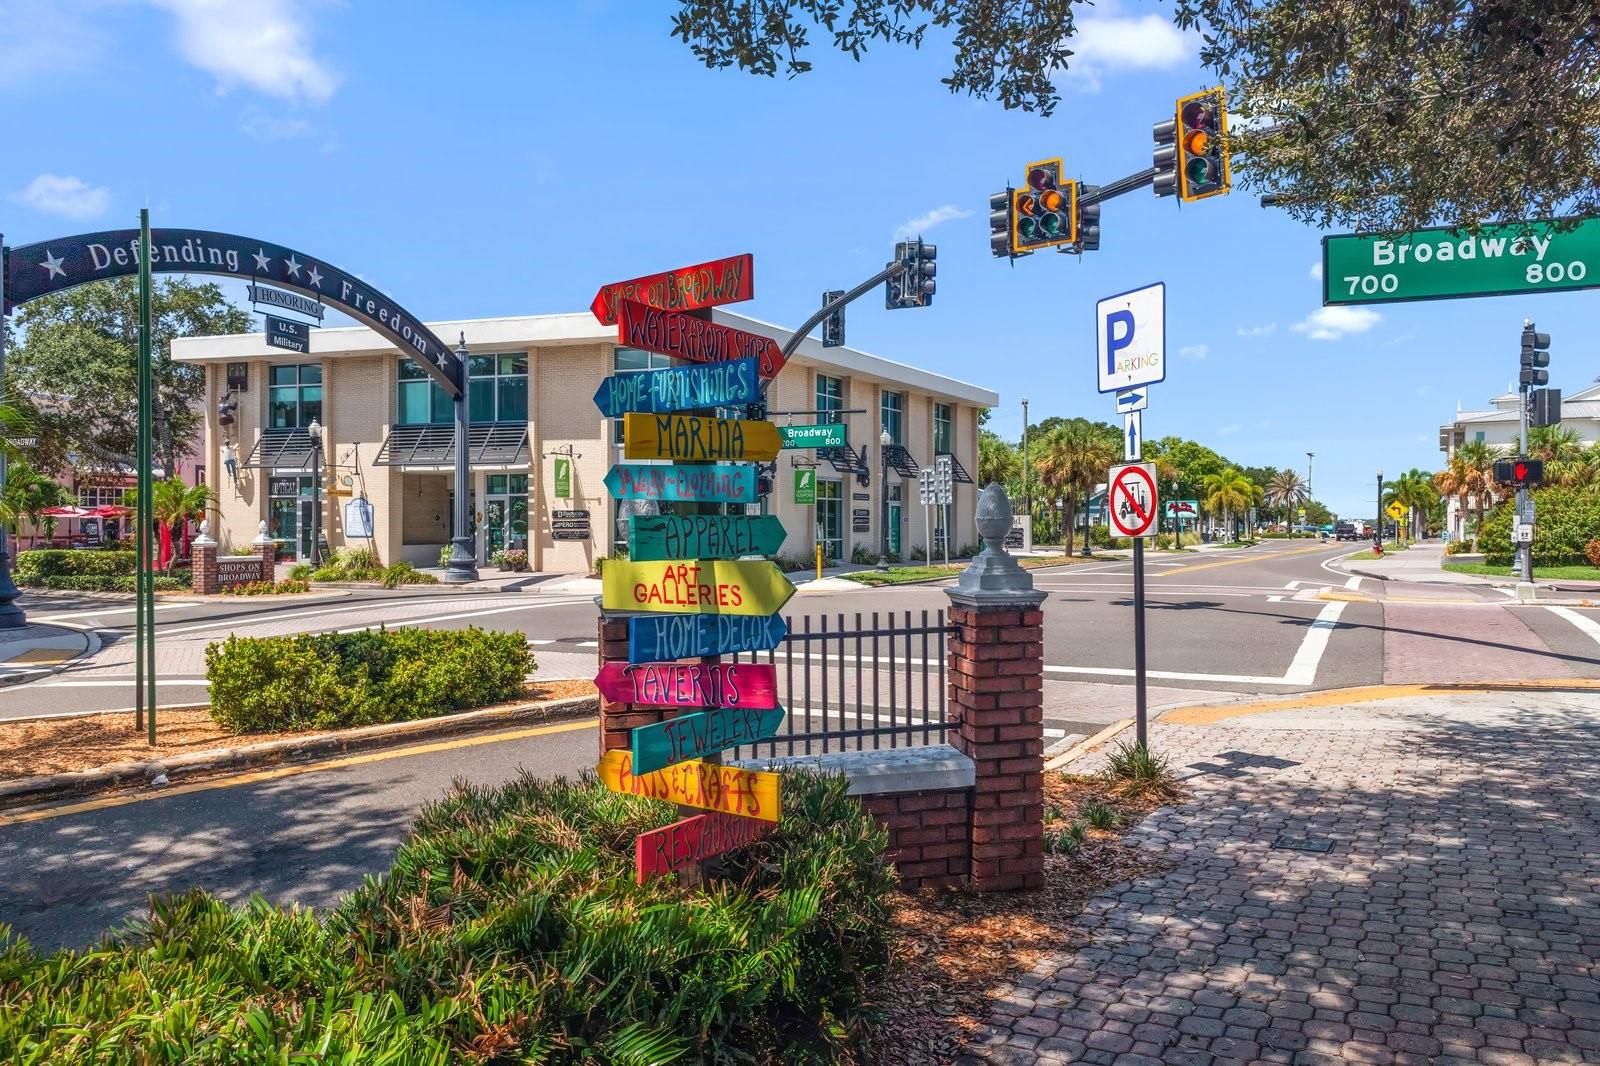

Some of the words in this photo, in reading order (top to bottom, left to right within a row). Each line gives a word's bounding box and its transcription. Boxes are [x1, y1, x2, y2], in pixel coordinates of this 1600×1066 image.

[87, 238, 239, 272] Defending
[1373, 234, 1553, 266] Broadway
[1343, 273, 1399, 295] 700
[1525, 260, 1587, 284] 800
[261, 289, 319, 315] HONORING
[278, 322, 298, 335] U.S.
[340, 280, 427, 354] Freedom
[273, 336, 304, 352] Military
[608, 374, 647, 415] HOME
[5, 437, 37, 447] OADWAY
[787, 428, 833, 438] Broadway
[272, 482, 296, 494] OPTICAL
[664, 515, 760, 559] APPAREL
[218, 573, 261, 582] BROADWAY
[219, 563, 245, 573] SHOPS
[248, 563, 260, 572] ON
[662, 564, 702, 585] ART
[633, 584, 743, 607] GALLERIES
[655, 615, 709, 660] HOME
[717, 615, 775, 653] DECOR
[681, 763, 761, 816] CRAFTS
